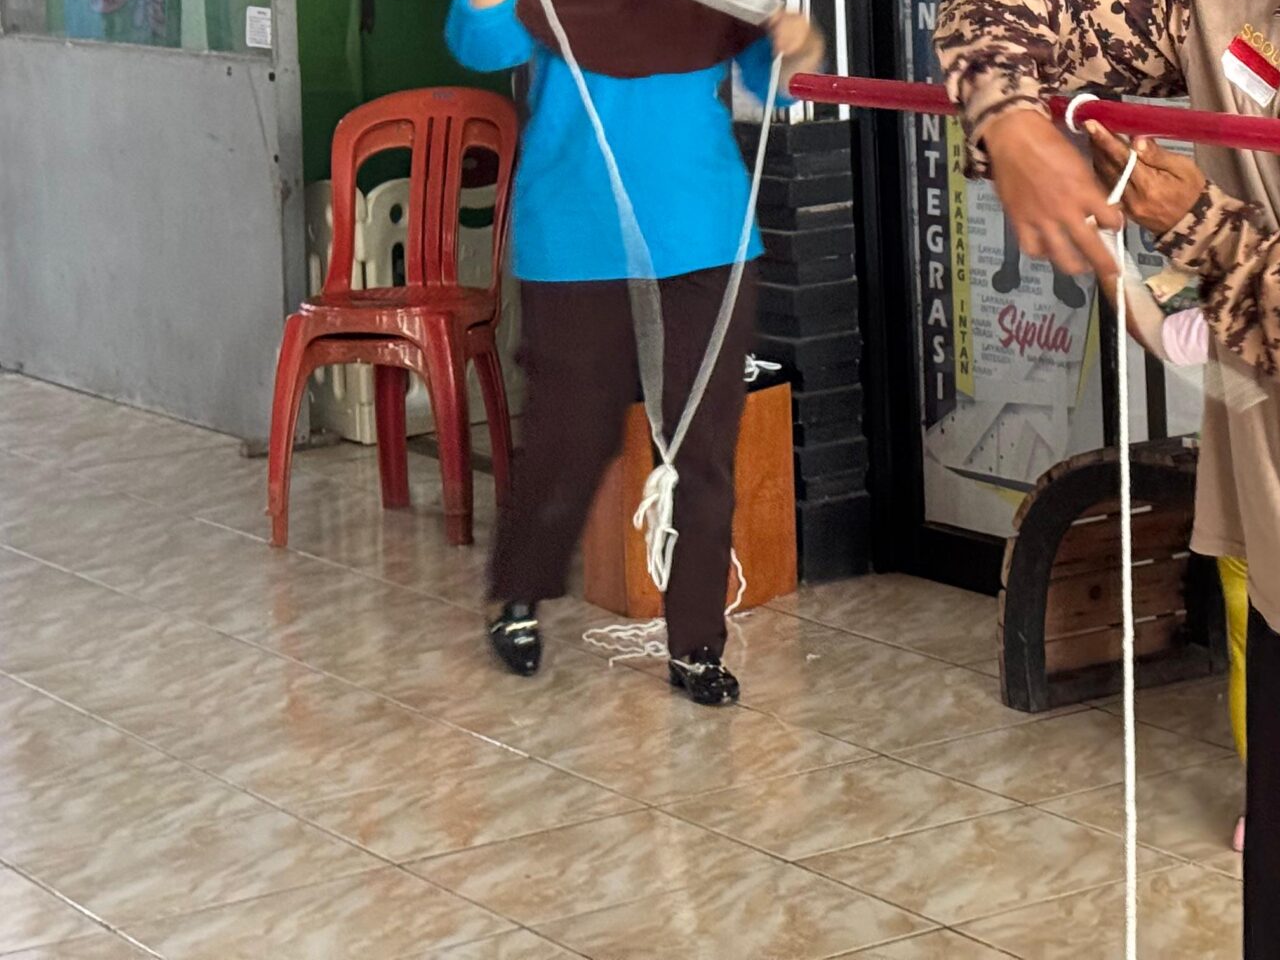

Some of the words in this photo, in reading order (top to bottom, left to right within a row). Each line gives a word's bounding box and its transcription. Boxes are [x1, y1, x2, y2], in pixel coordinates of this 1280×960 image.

[922, 77, 947, 399] NTEGRASI
[954, 192, 965, 281] KARANG
[958, 300, 969, 375] INTAN
[998, 304, 1072, 357] Sipila
